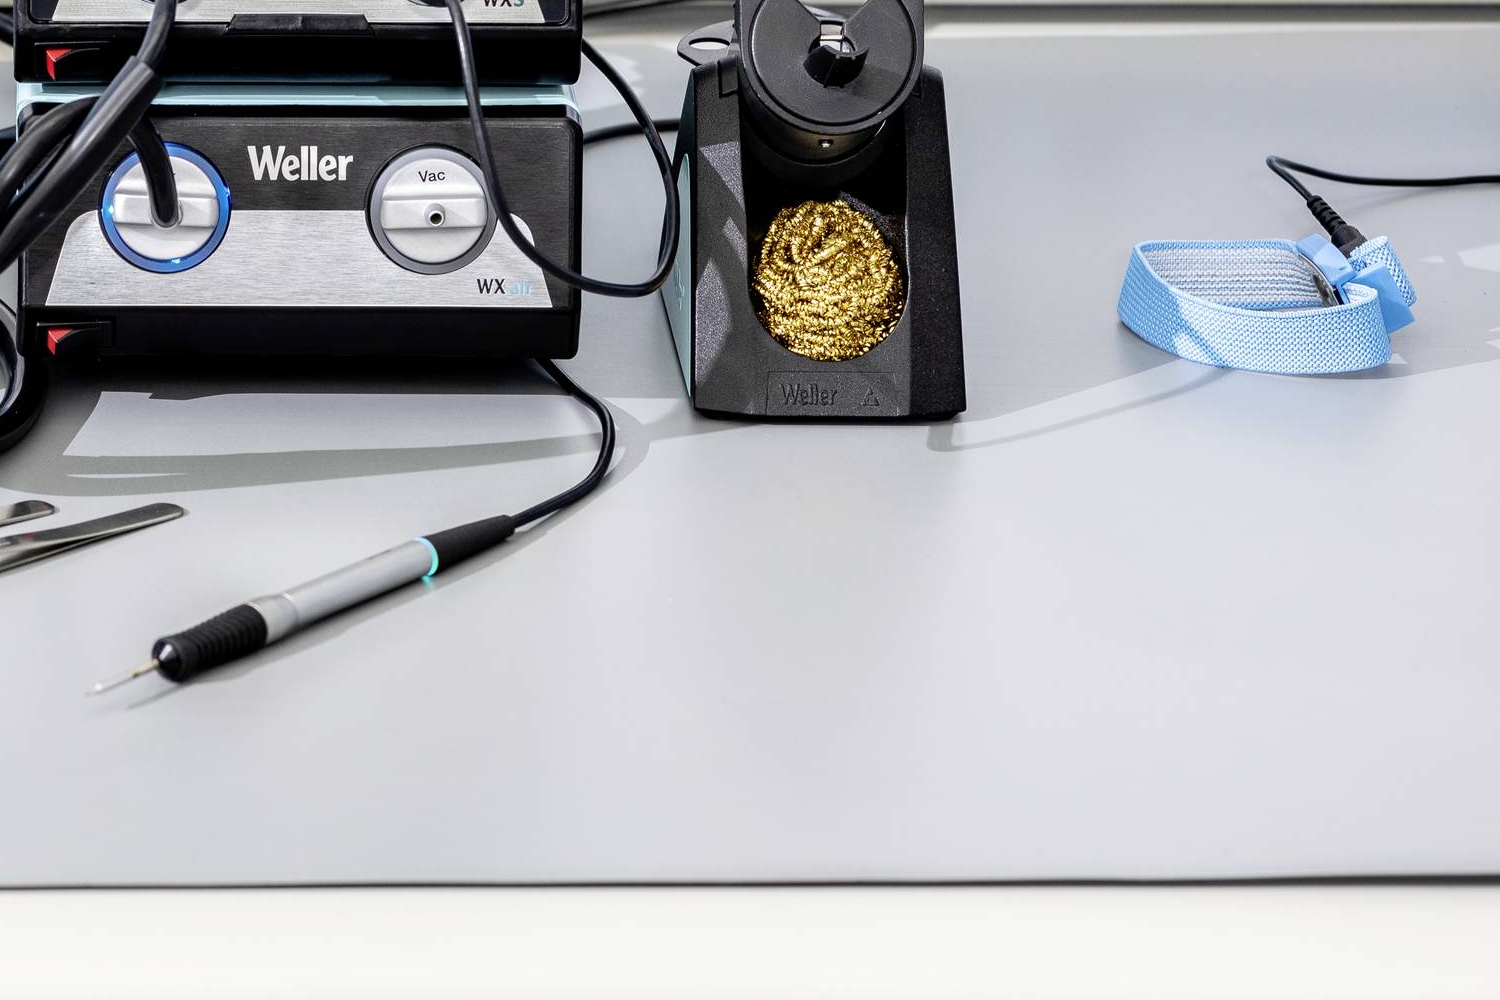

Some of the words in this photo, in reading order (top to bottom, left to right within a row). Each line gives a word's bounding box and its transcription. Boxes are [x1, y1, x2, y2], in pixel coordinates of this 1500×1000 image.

[246, 144, 354, 182] Weller
[418, 170, 446, 183] Vac
[781, 383, 838, 406] Weller
